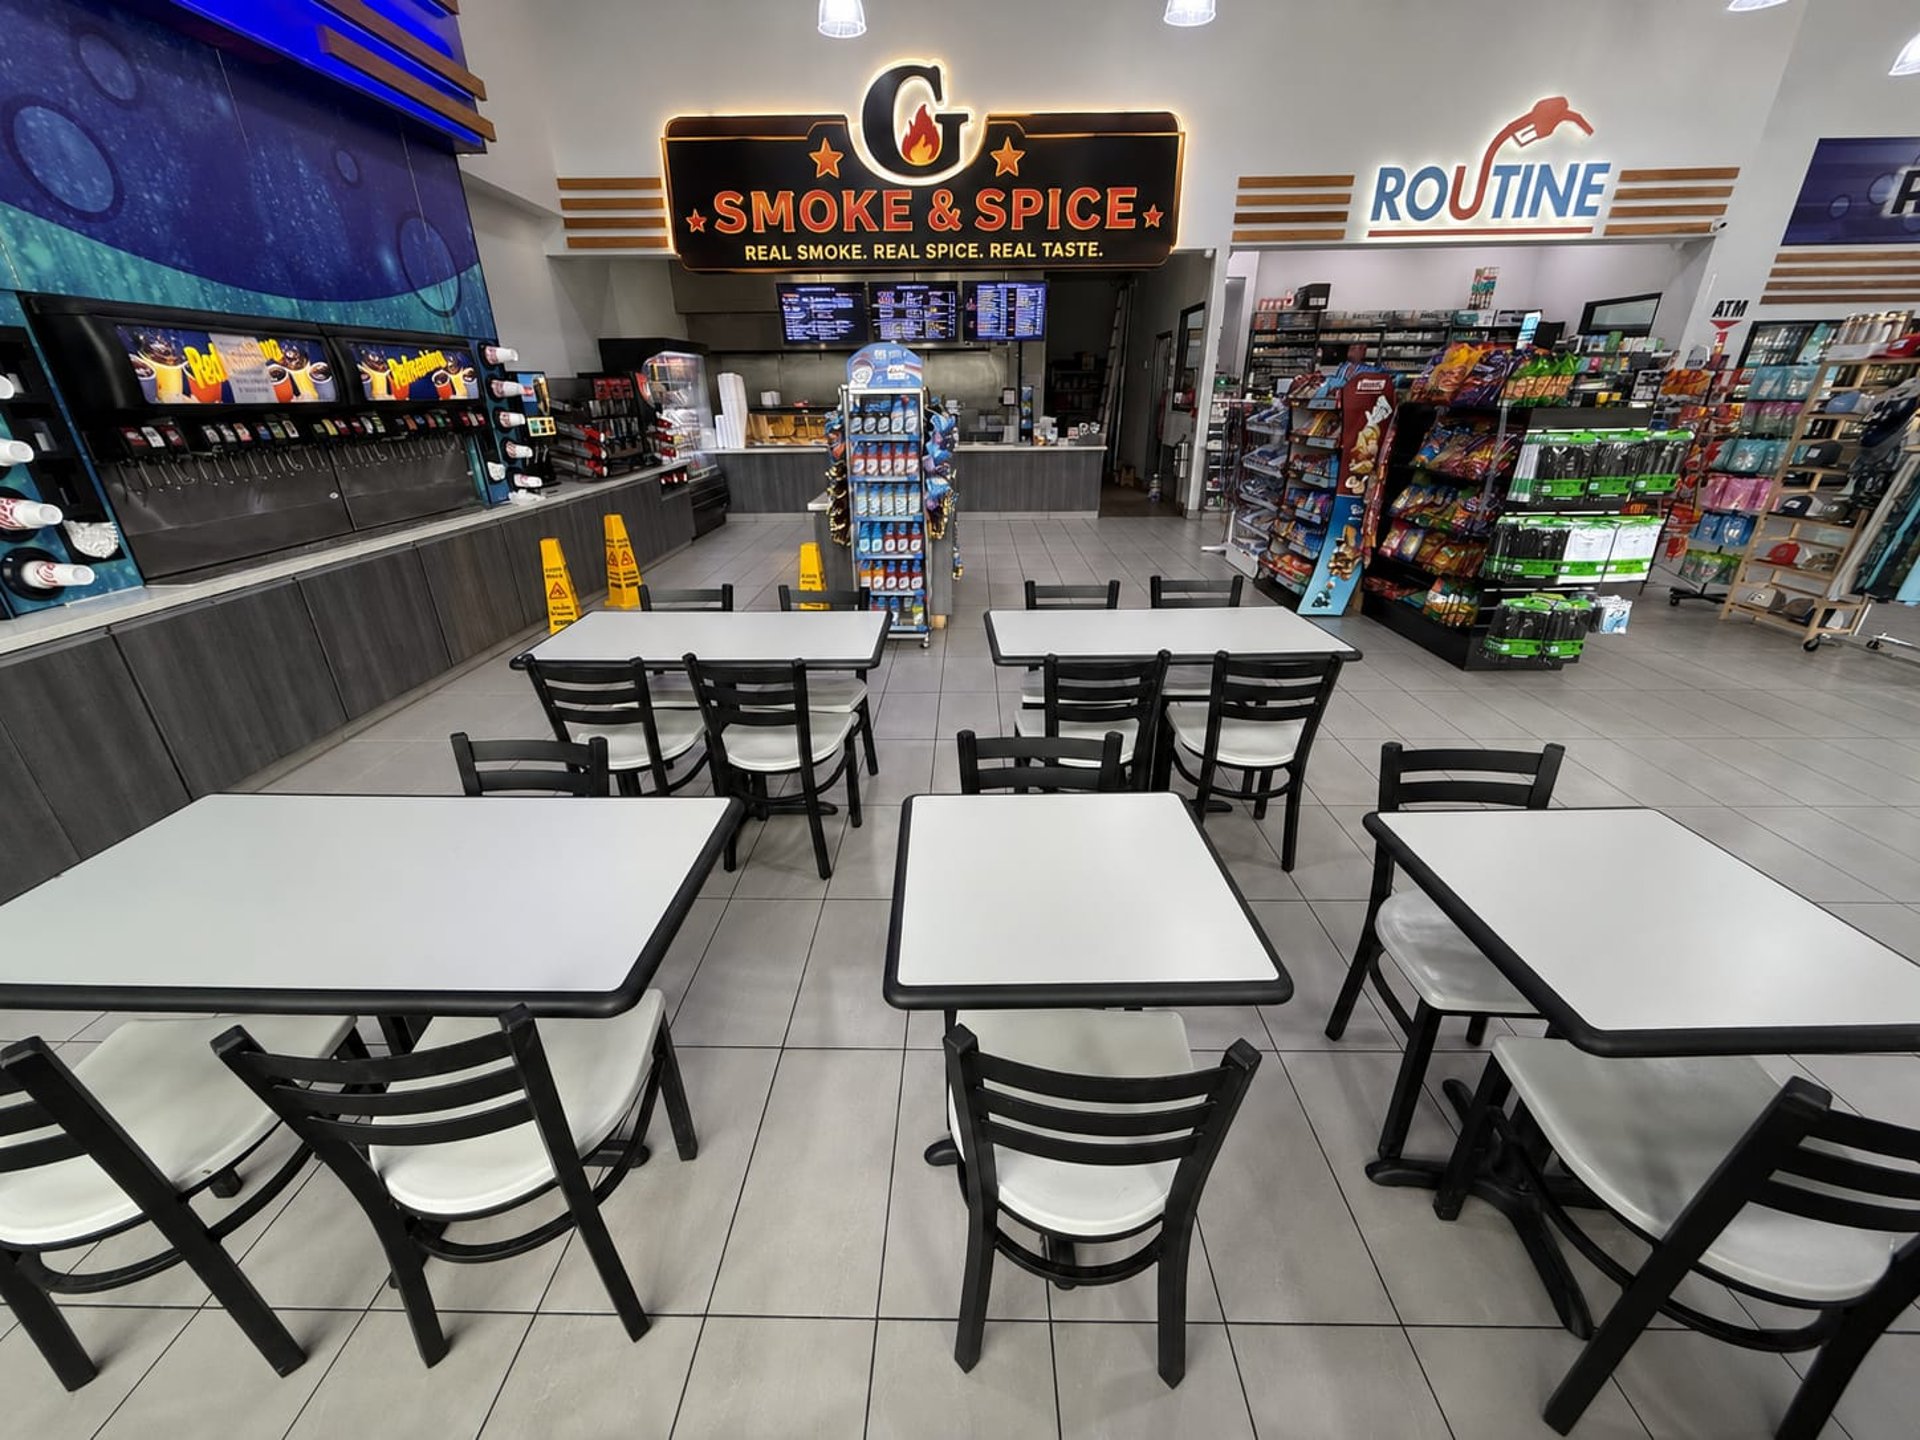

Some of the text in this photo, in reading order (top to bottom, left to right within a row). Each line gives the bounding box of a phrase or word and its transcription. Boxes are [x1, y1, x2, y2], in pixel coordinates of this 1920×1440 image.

[863, 65, 969, 177] G
[713, 186, 1138, 234] SMOKE & SPICE
[1370, 162, 1611, 222] ROUTINE
[745, 241, 1103, 261] REAL SMOKE. REAL SPICE. REAL TASTE.
[1712, 299, 1749, 318] ATM
